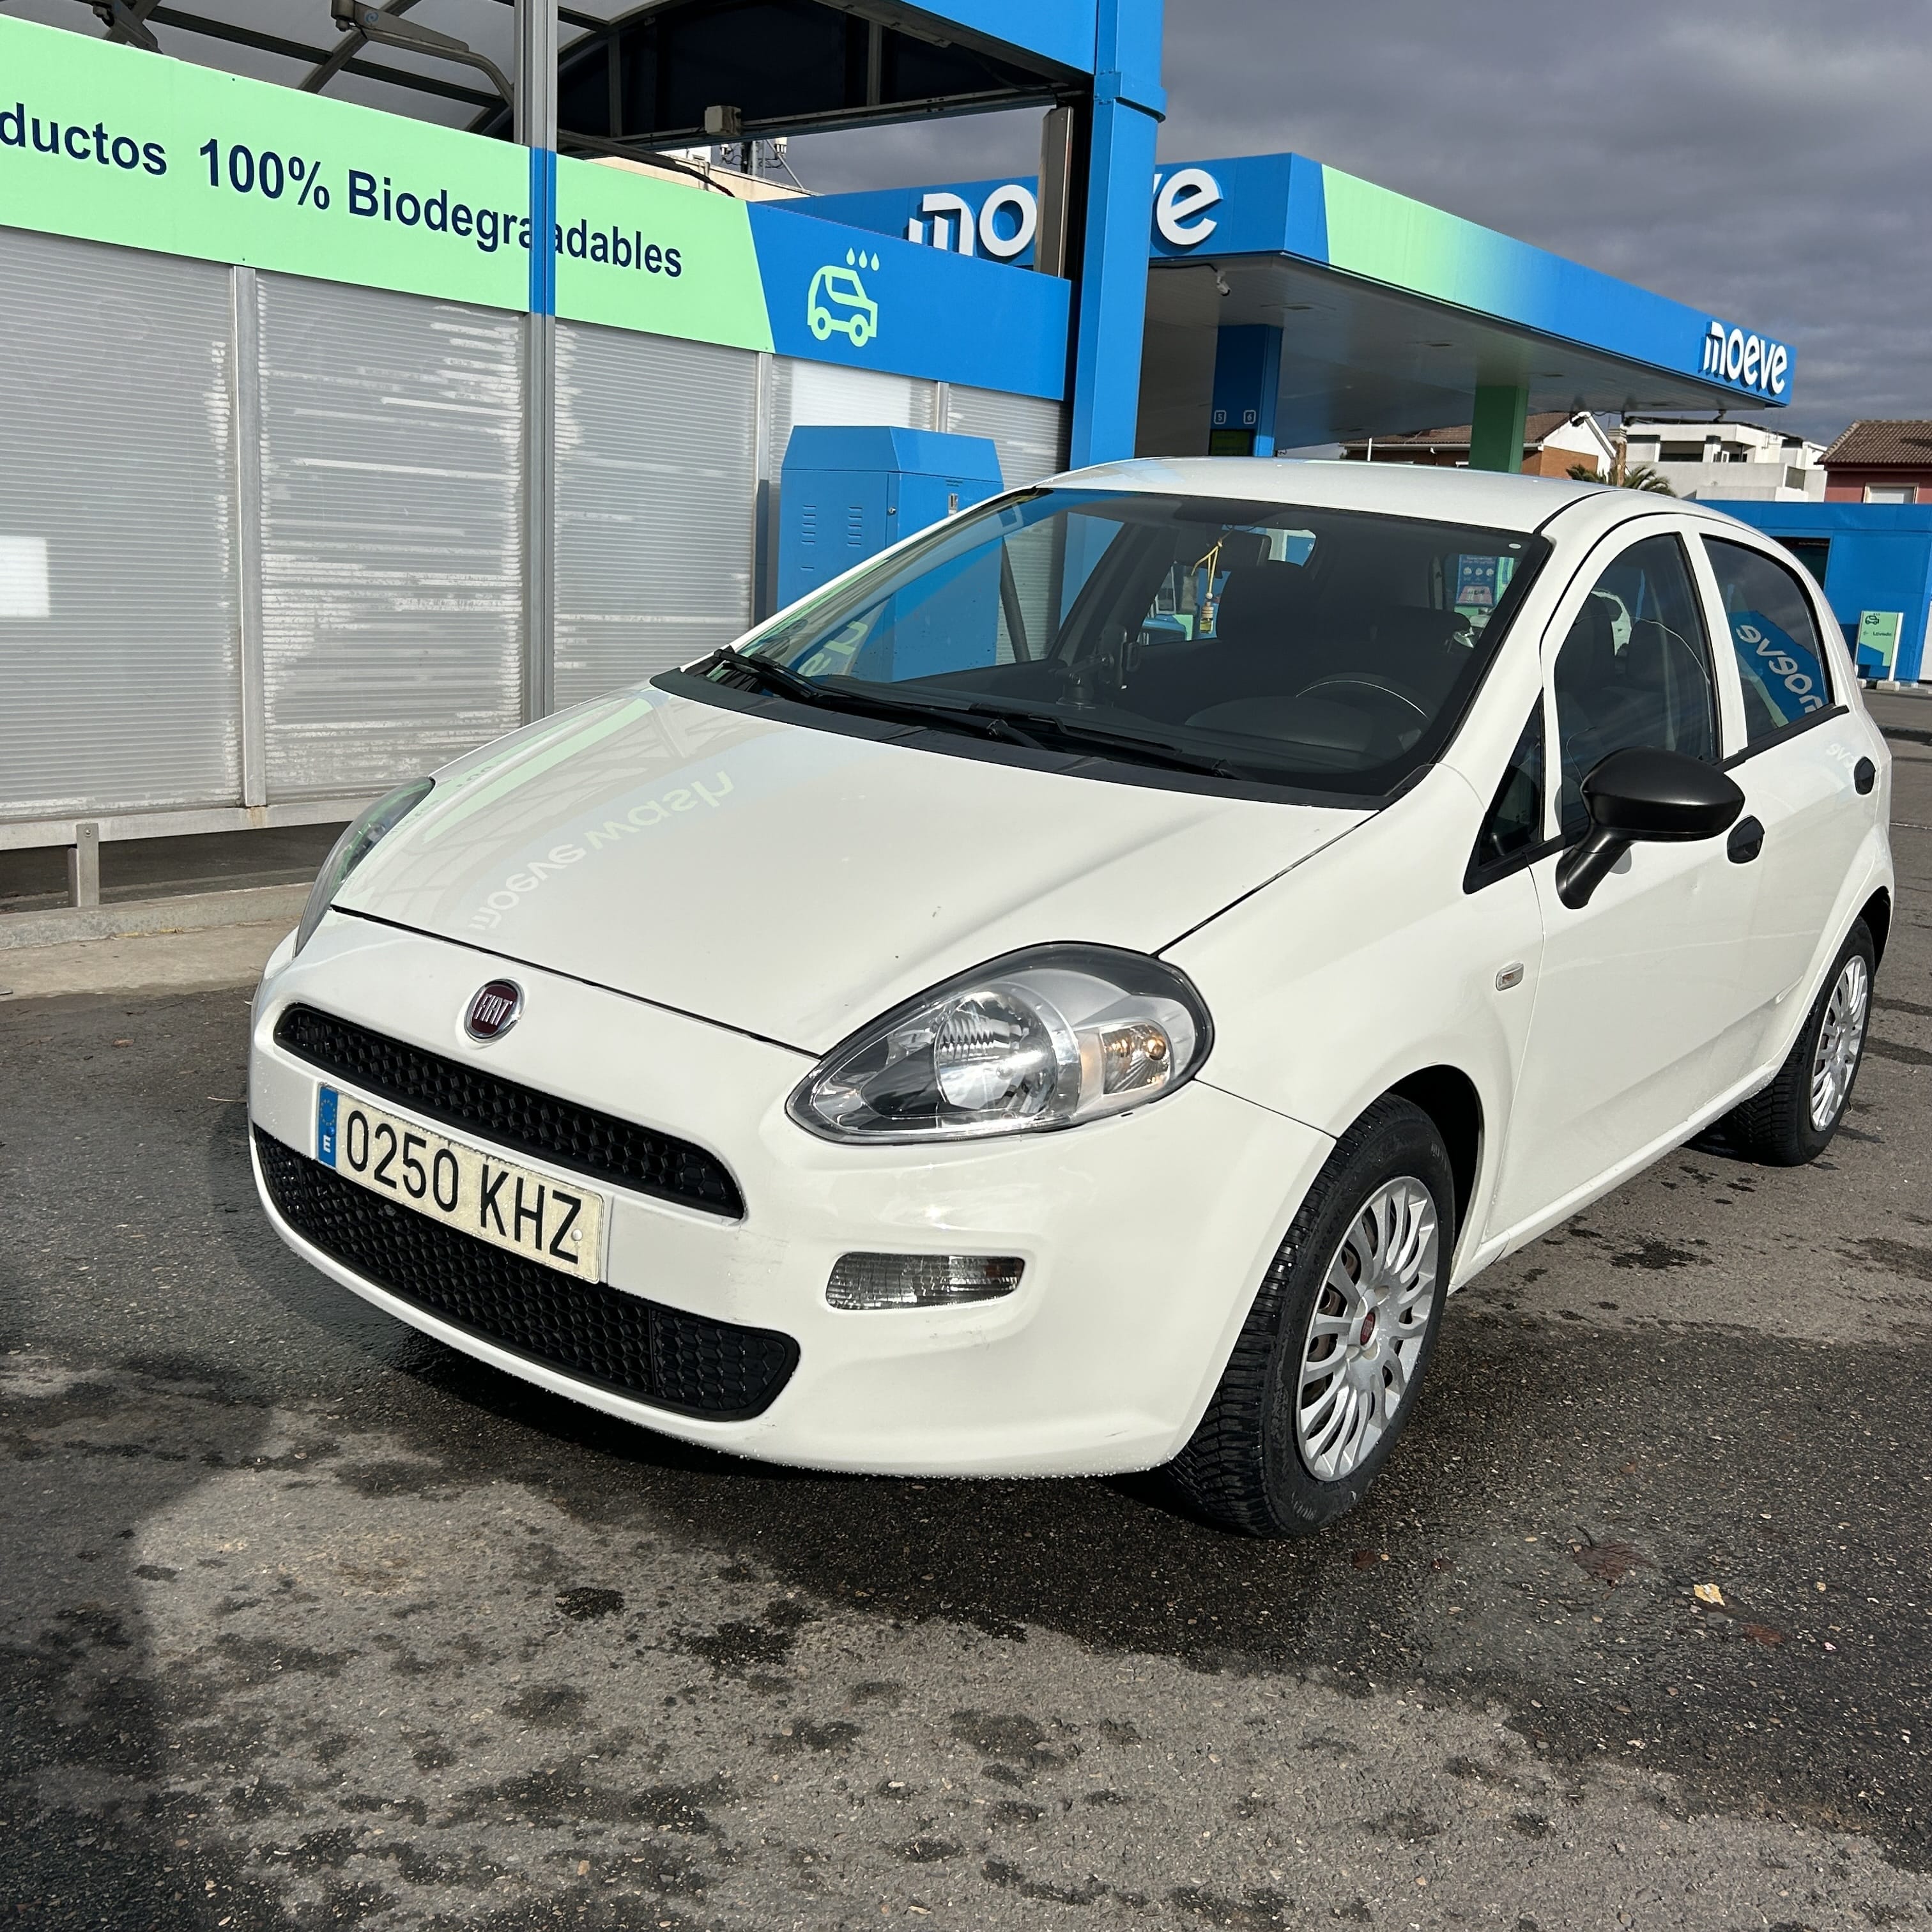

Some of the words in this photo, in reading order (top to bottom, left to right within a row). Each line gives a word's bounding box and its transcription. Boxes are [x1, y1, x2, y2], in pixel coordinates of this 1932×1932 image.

[0, 102, 167, 176] ductos
[199, 138, 330, 210] 100%
[1703, 321, 1788, 394] moeve
[474, 993, 513, 1026] FIAT
[323, 1135, 331, 1153] E
[346, 1110, 459, 1213] 0250
[480, 1164, 582, 1265] KHZ
